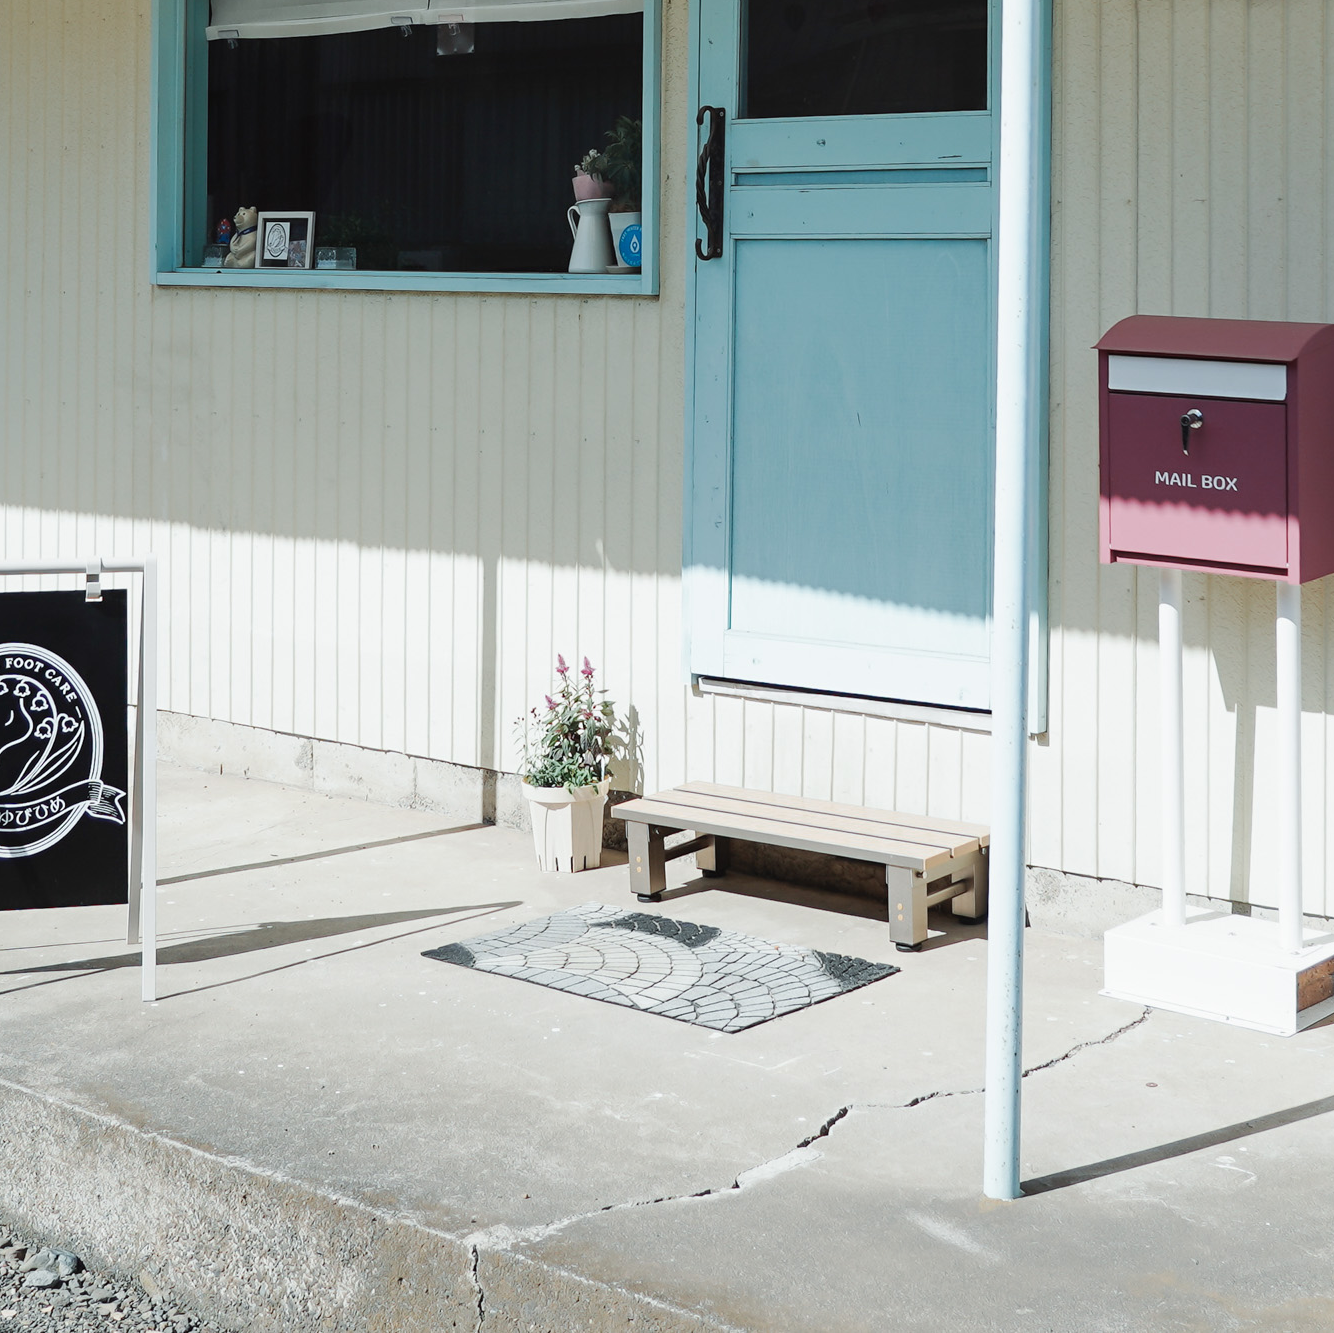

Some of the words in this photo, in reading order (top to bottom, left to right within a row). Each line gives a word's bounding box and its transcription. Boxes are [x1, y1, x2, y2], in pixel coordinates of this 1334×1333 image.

[1155, 470, 1197, 488] MAIL
[1201, 474, 1238, 492] BOX
[5, 657, 45, 671] FOOT
[44, 668, 78, 703] CARE
